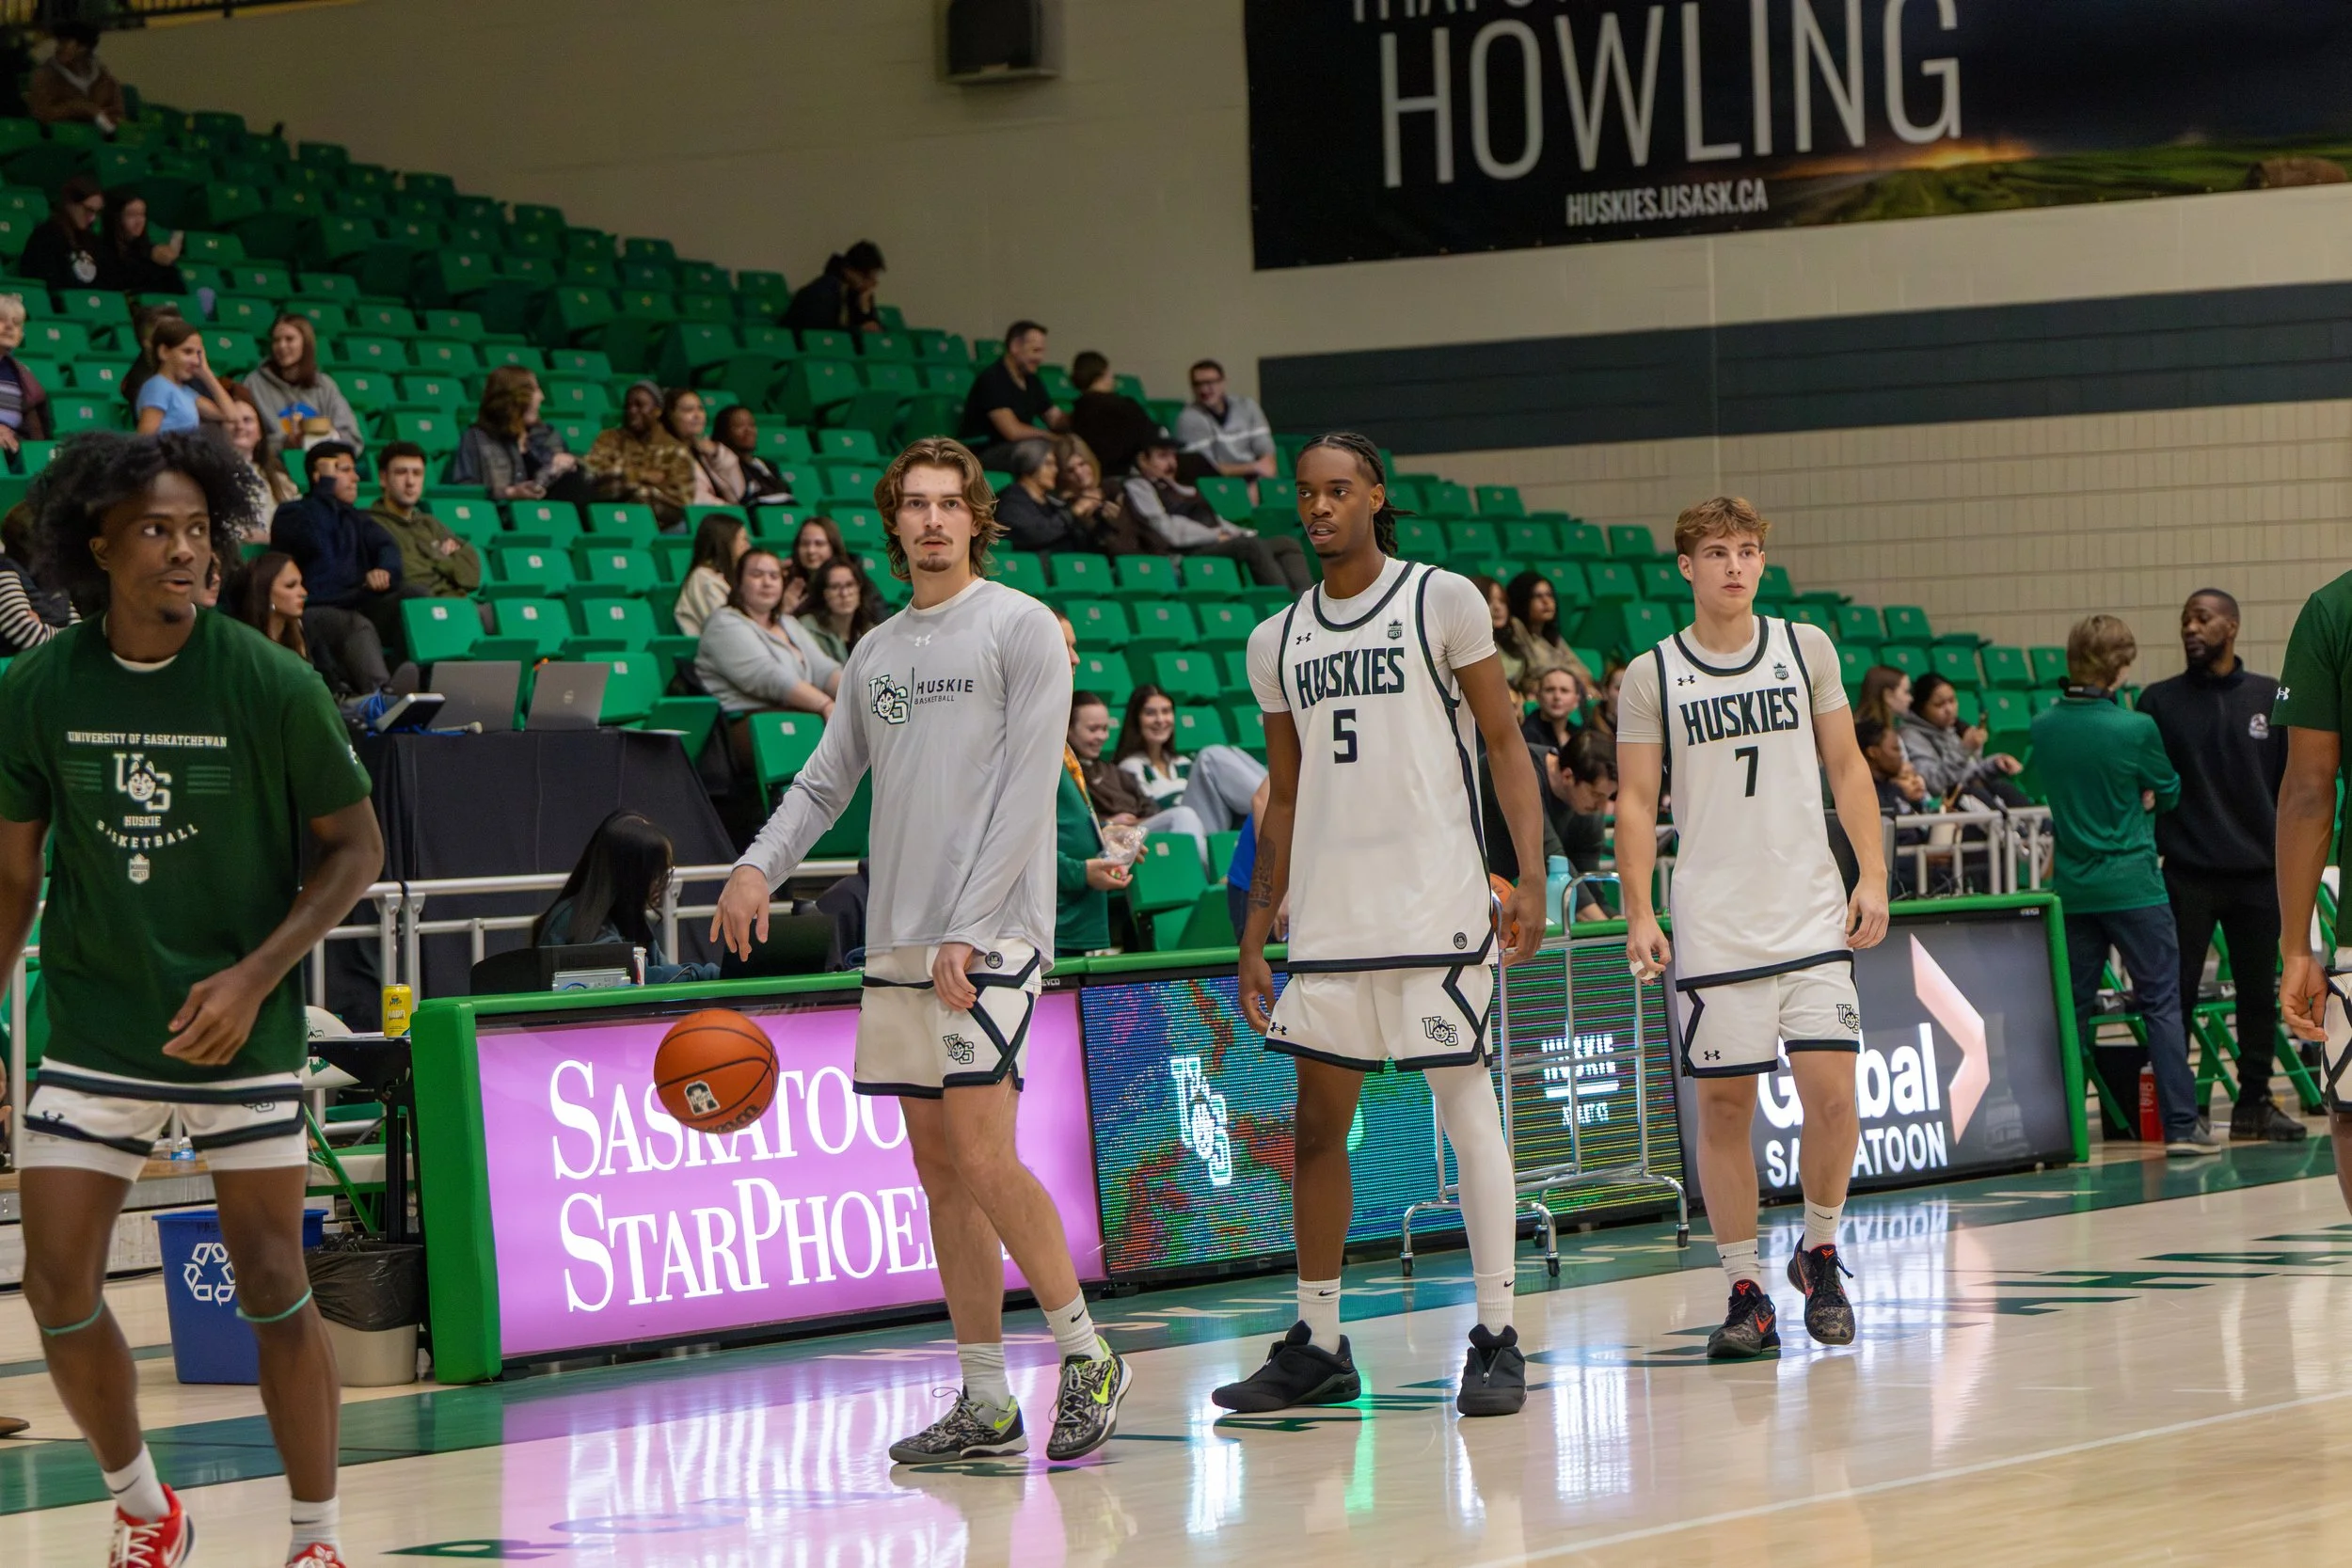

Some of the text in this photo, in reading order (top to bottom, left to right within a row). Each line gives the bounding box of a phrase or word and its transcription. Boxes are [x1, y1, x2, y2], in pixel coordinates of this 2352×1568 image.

[1380, 0, 1962, 187] HOWLING
[1565, 178, 1768, 227] HUSKIES.USASK.CA
[914, 695, 955, 705] BASKETBALL
[915, 679, 974, 694] HUSKIE
[1295, 647, 1405, 709] HUSKIES
[68, 731, 227, 747] UNIVERSITY OF SASKATCHEWAN
[1333, 708, 1358, 764] 5
[1678, 687, 1799, 746] HUSKIES
[1734, 746, 1759, 798] 7
[123, 816, 161, 827] HUSKIE
[1757, 1022, 1940, 1129] Gbal
[1765, 1121, 1948, 1188] SATOON
